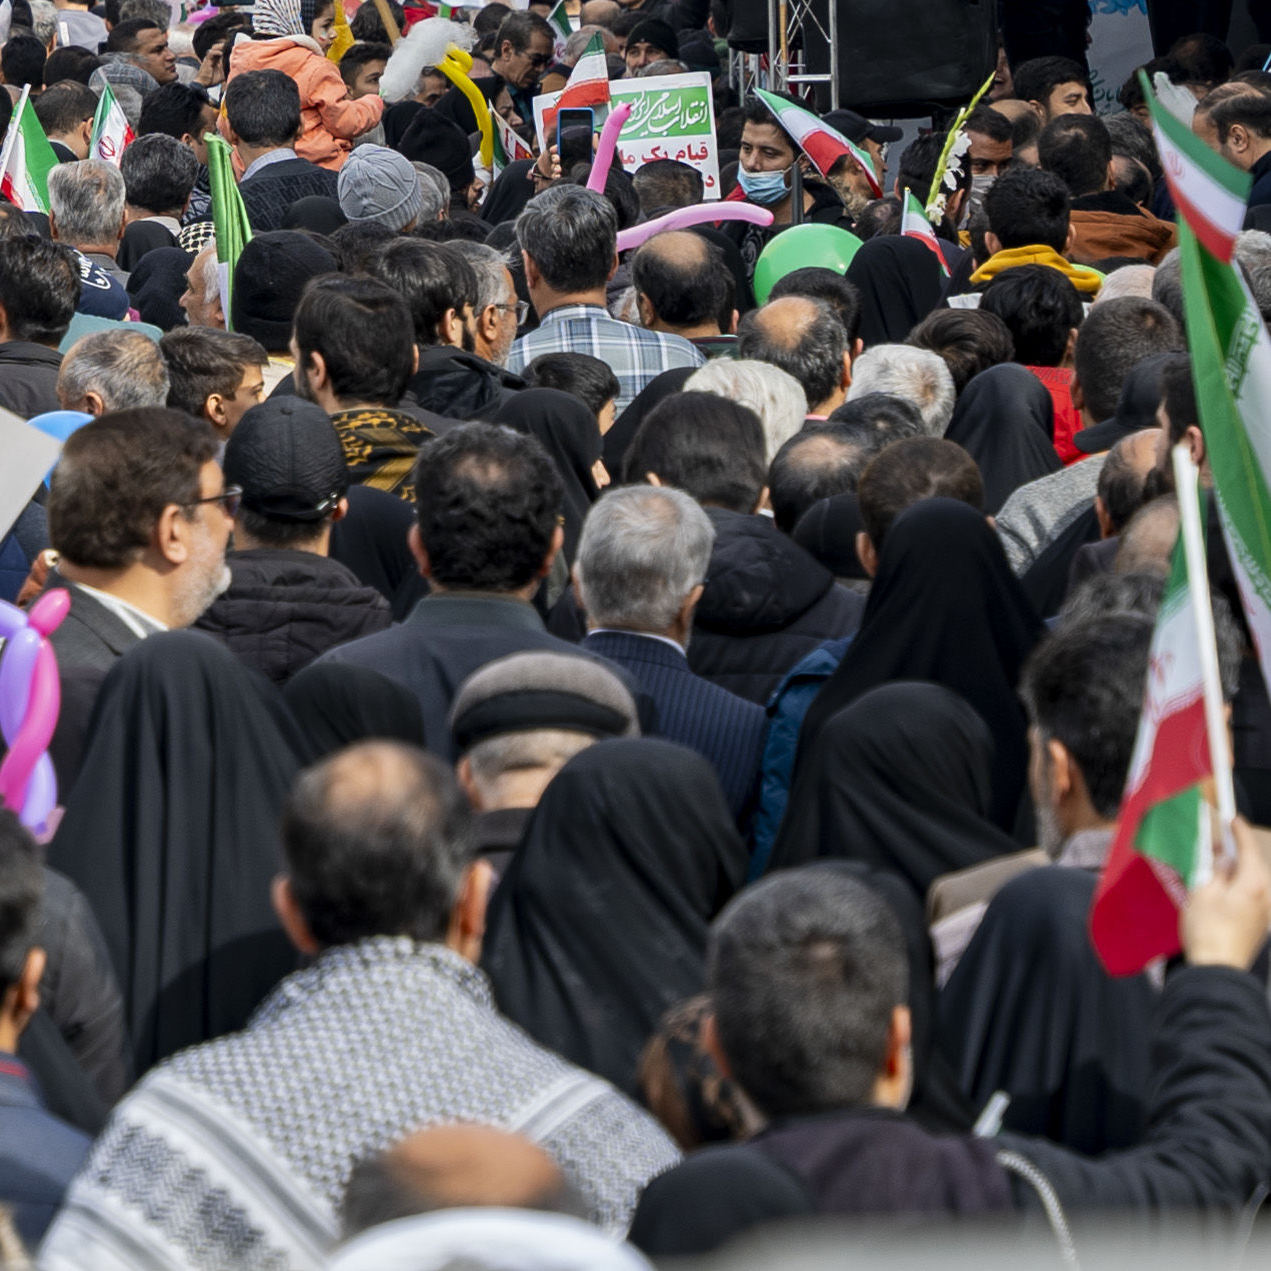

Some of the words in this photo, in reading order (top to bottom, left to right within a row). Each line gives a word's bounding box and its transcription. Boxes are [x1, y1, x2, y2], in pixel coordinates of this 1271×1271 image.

[619, 91, 682, 137] اسلامی
[648, 99, 708, 136] انقلاب
[675, 141, 709, 166] قیام
